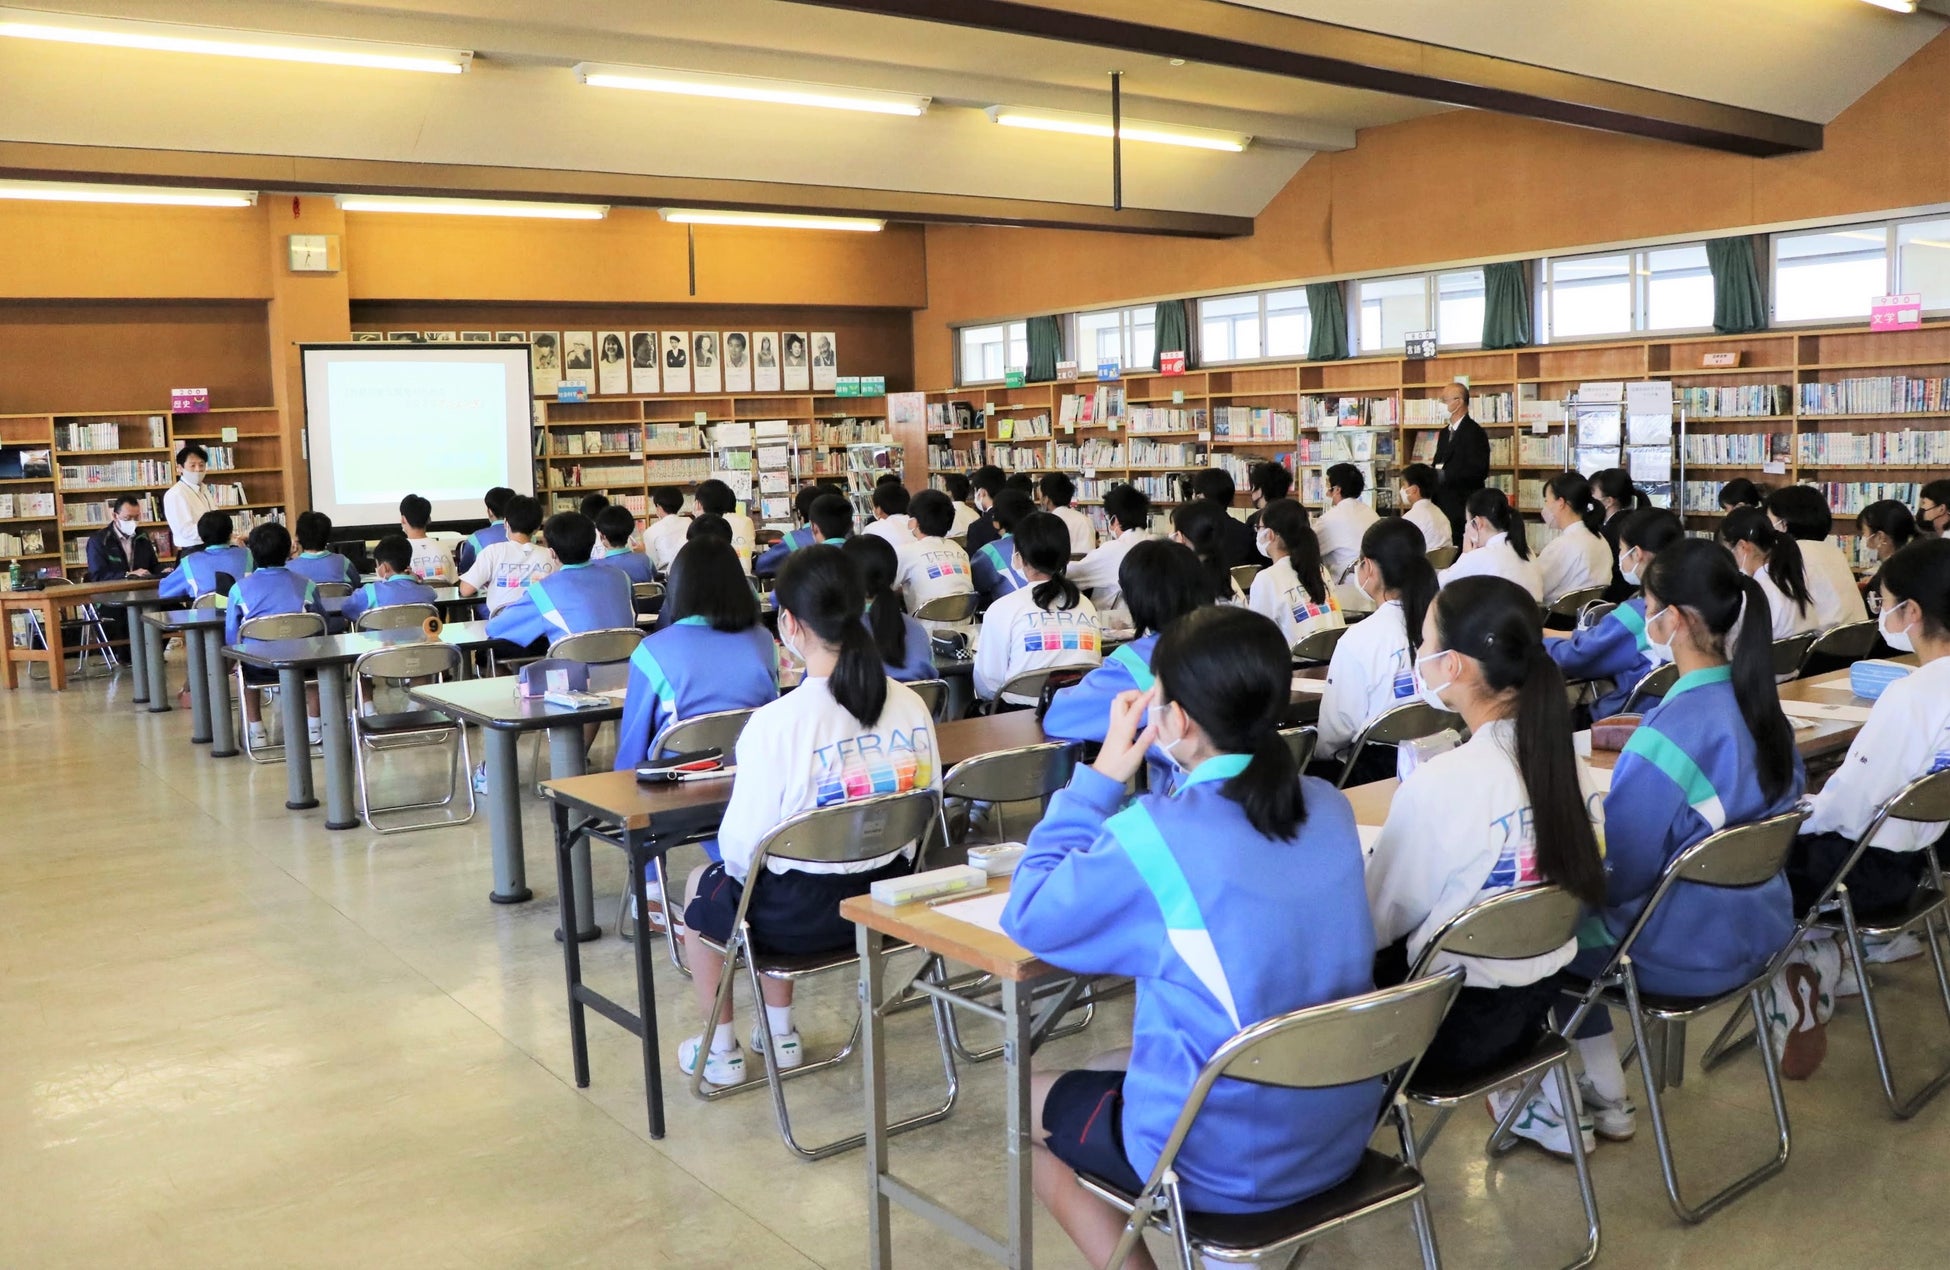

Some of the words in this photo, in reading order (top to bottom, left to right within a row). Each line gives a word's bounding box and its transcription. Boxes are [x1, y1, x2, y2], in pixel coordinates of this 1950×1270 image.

[1880, 296, 1910, 304] 900
[1872, 312, 1896, 324] 文学
[429, 619, 439, 632] 9
